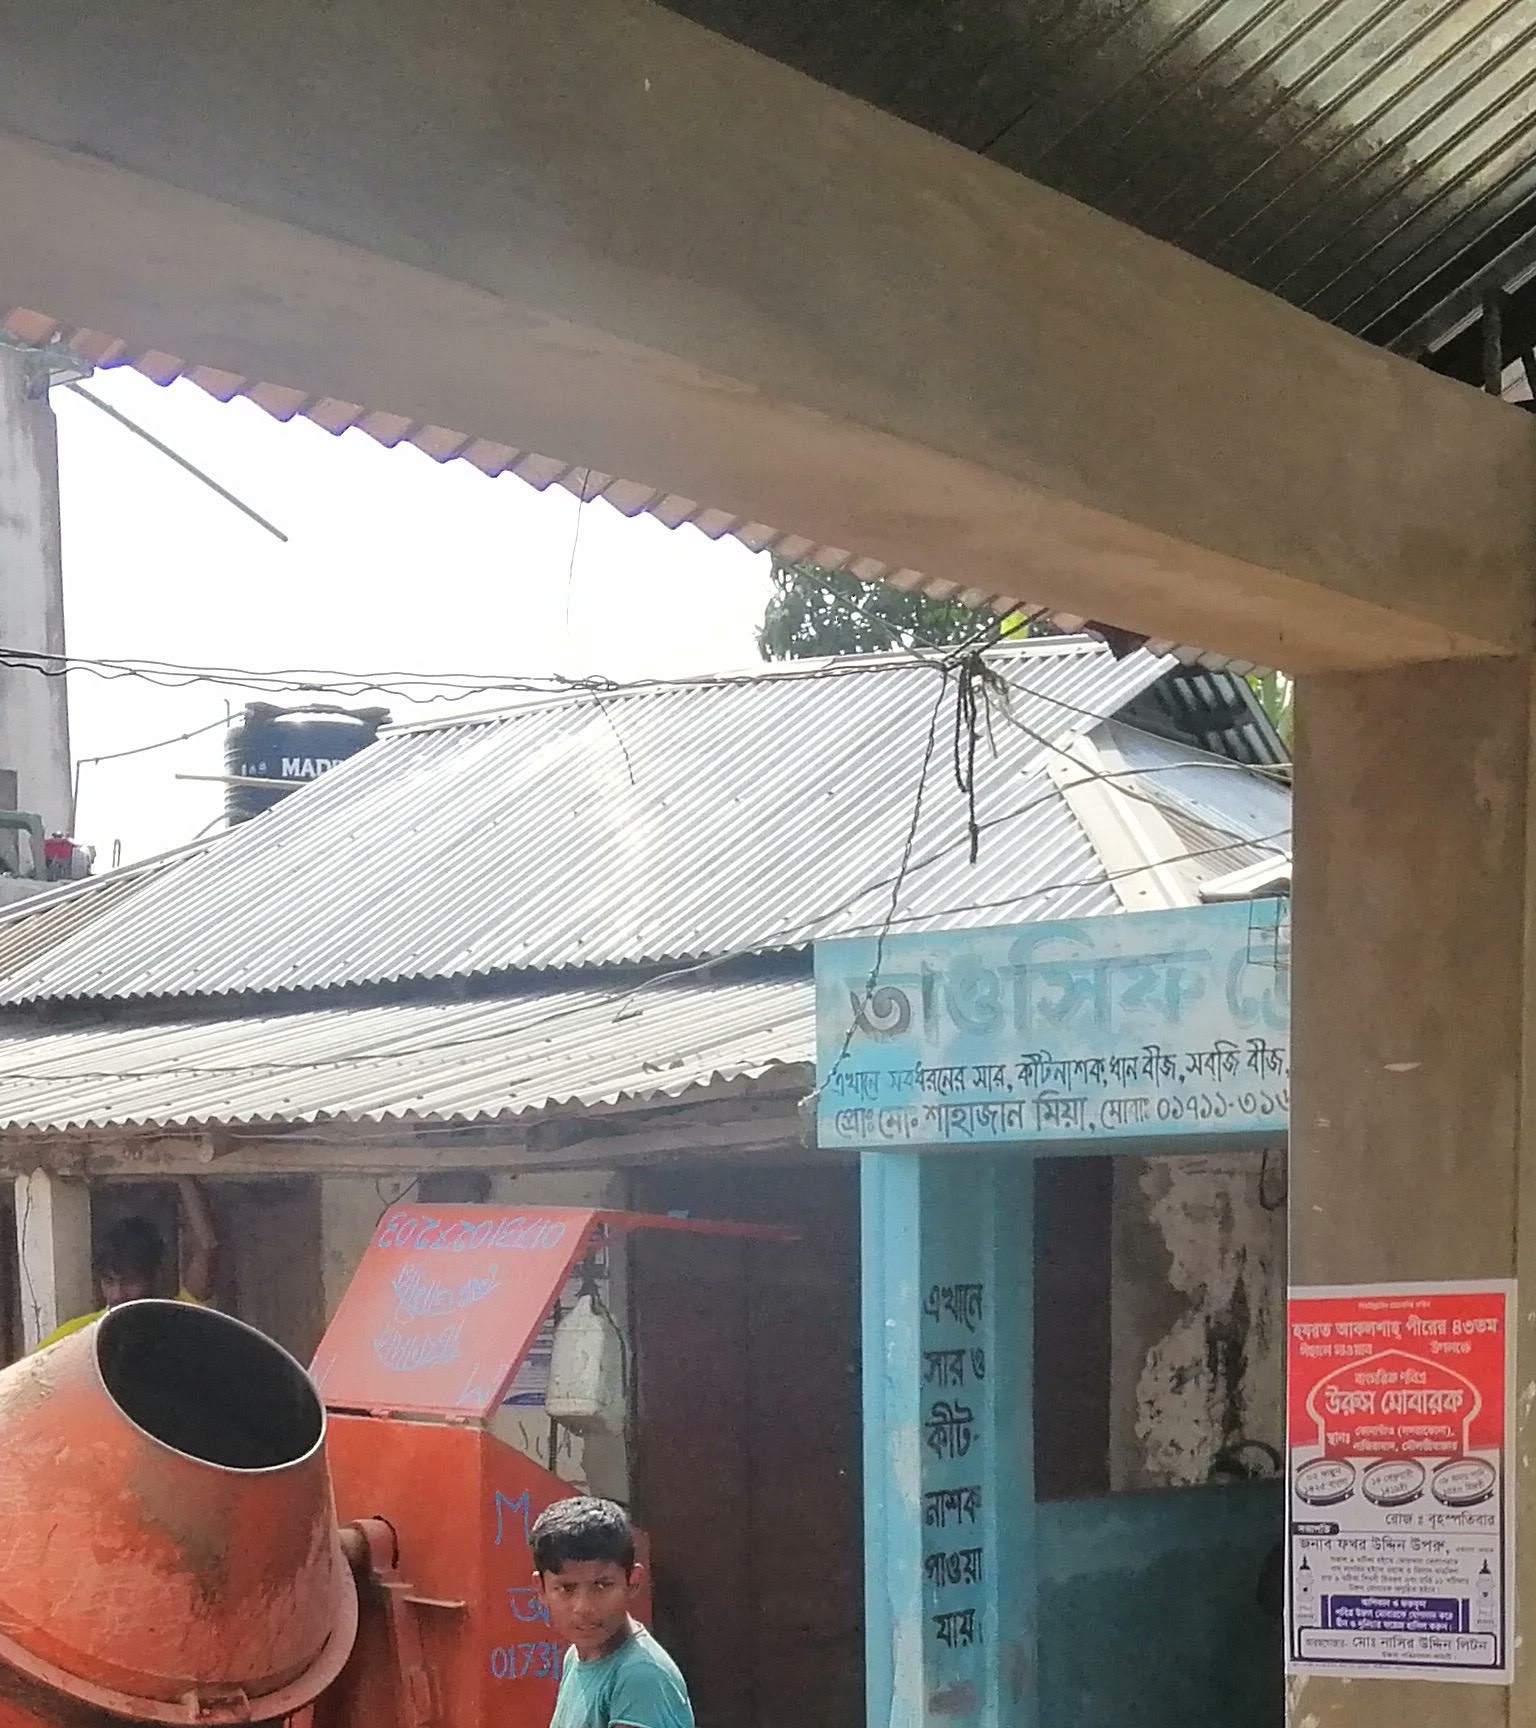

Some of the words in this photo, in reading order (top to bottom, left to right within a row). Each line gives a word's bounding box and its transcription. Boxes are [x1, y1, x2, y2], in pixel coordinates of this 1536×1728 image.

[831, 1070, 880, 1101] এখানে
[924, 1284, 983, 1331] এখানে
[1381, 1389, 1464, 1416] মোবারক
[491, 1643, 563, 1681] 01731
